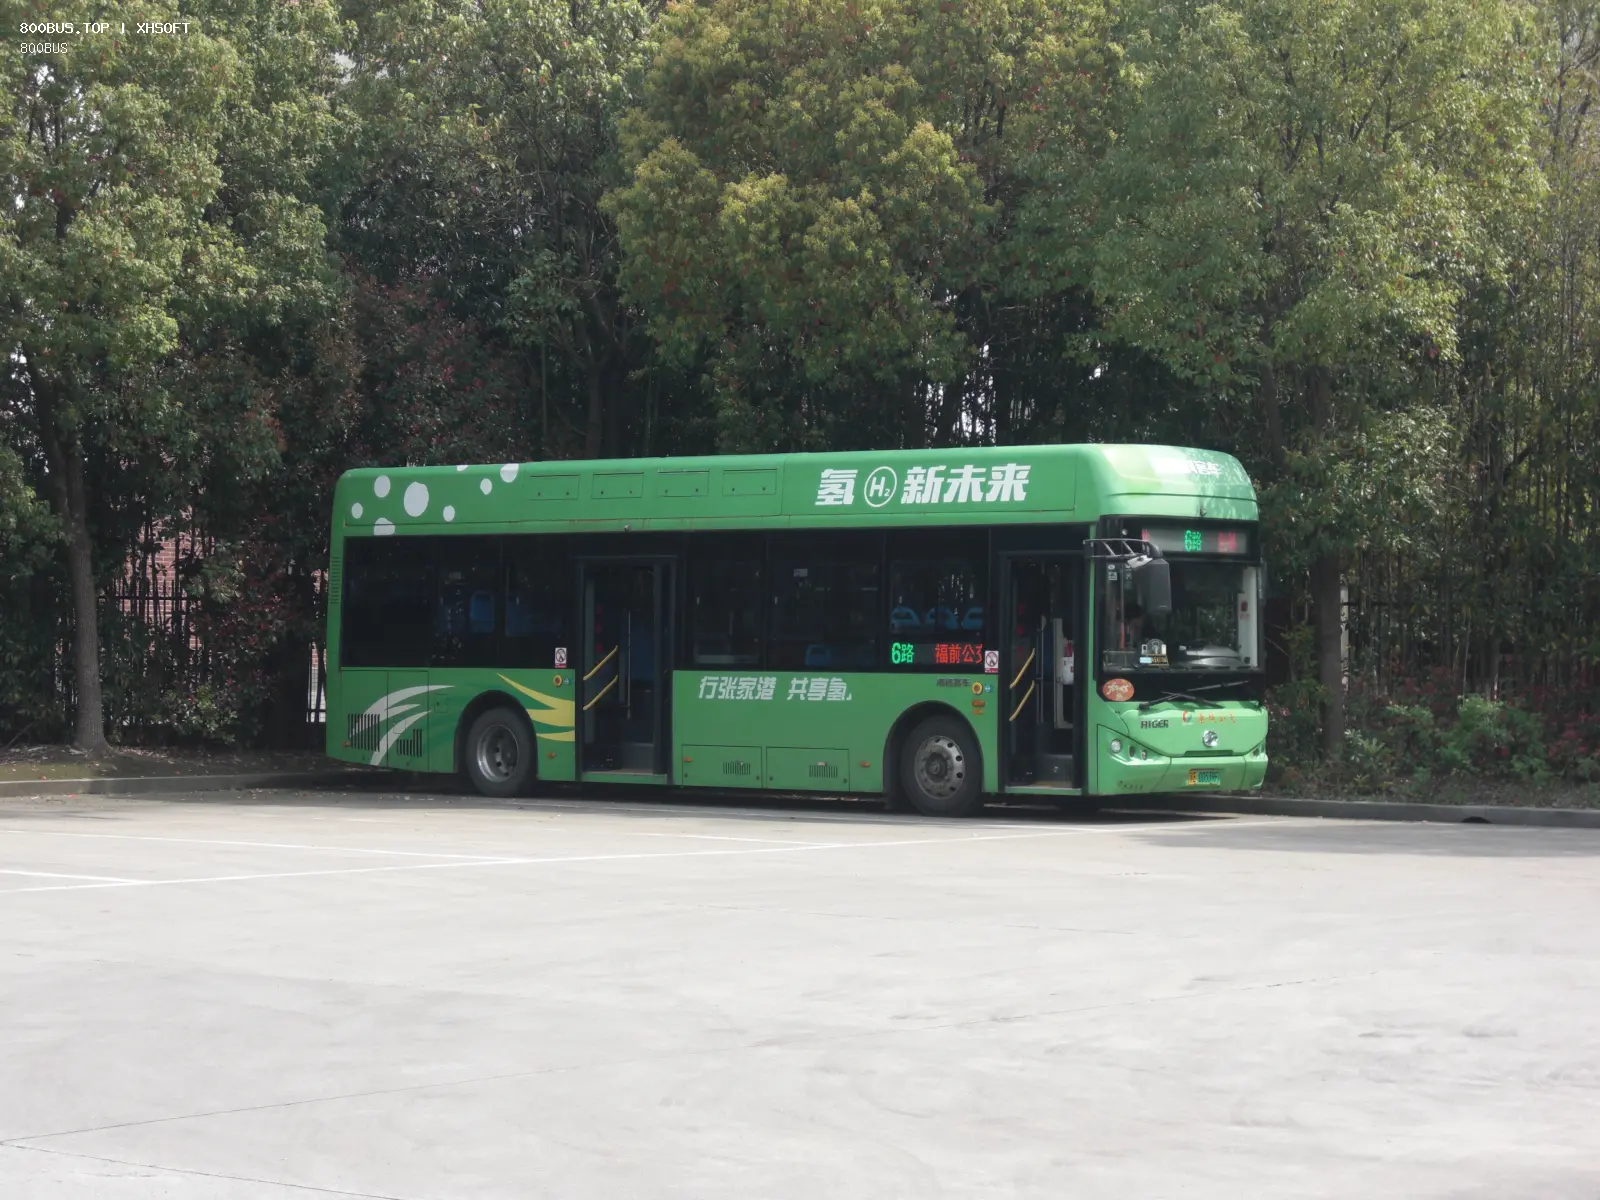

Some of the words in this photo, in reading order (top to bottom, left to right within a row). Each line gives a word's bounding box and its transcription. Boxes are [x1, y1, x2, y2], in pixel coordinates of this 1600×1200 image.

[815, 468, 858, 506] 氢
[900, 463, 1031, 505] 新未来
[891, 642, 915, 664] 6路
[698, 675, 777, 701] 行张家港
[1140, 719, 1169, 729] HIGER
